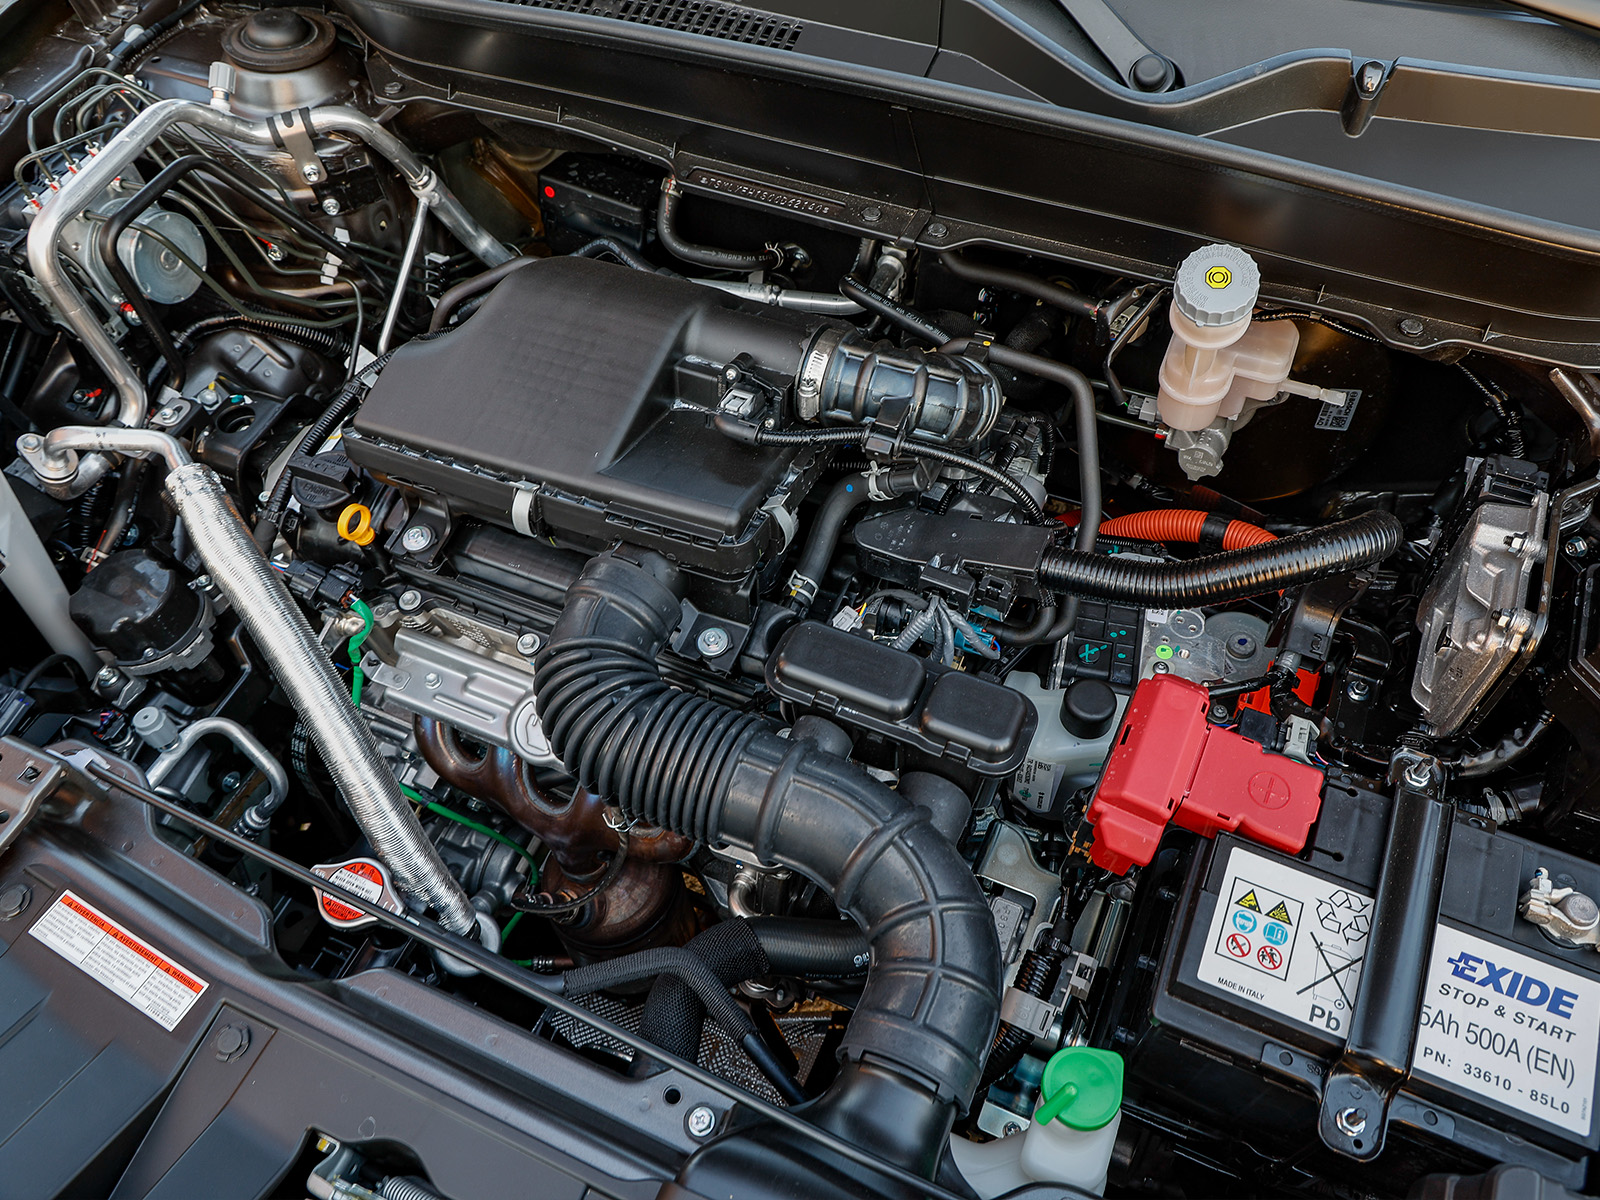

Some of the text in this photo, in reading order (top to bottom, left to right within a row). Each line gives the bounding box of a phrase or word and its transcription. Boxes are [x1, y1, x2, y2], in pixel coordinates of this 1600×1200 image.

[303, 482, 332, 497] ENGINE
[305, 493, 317, 504] OIL
[1217, 976, 1265, 1001] MADE IN ITALY
[1447, 951, 1579, 1020] EXIDE
[1308, 1003, 1341, 1032] Pb
[1438, 983, 1577, 1043] STOP & START
[1465, 1022, 1521, 1063] 500A
[1526, 1045, 1575, 1089] (EN)
[1423, 1046, 1452, 1068] PN:
[1463, 1062, 1512, 1091] 33610
[1529, 1089, 1570, 1114] 85L0
